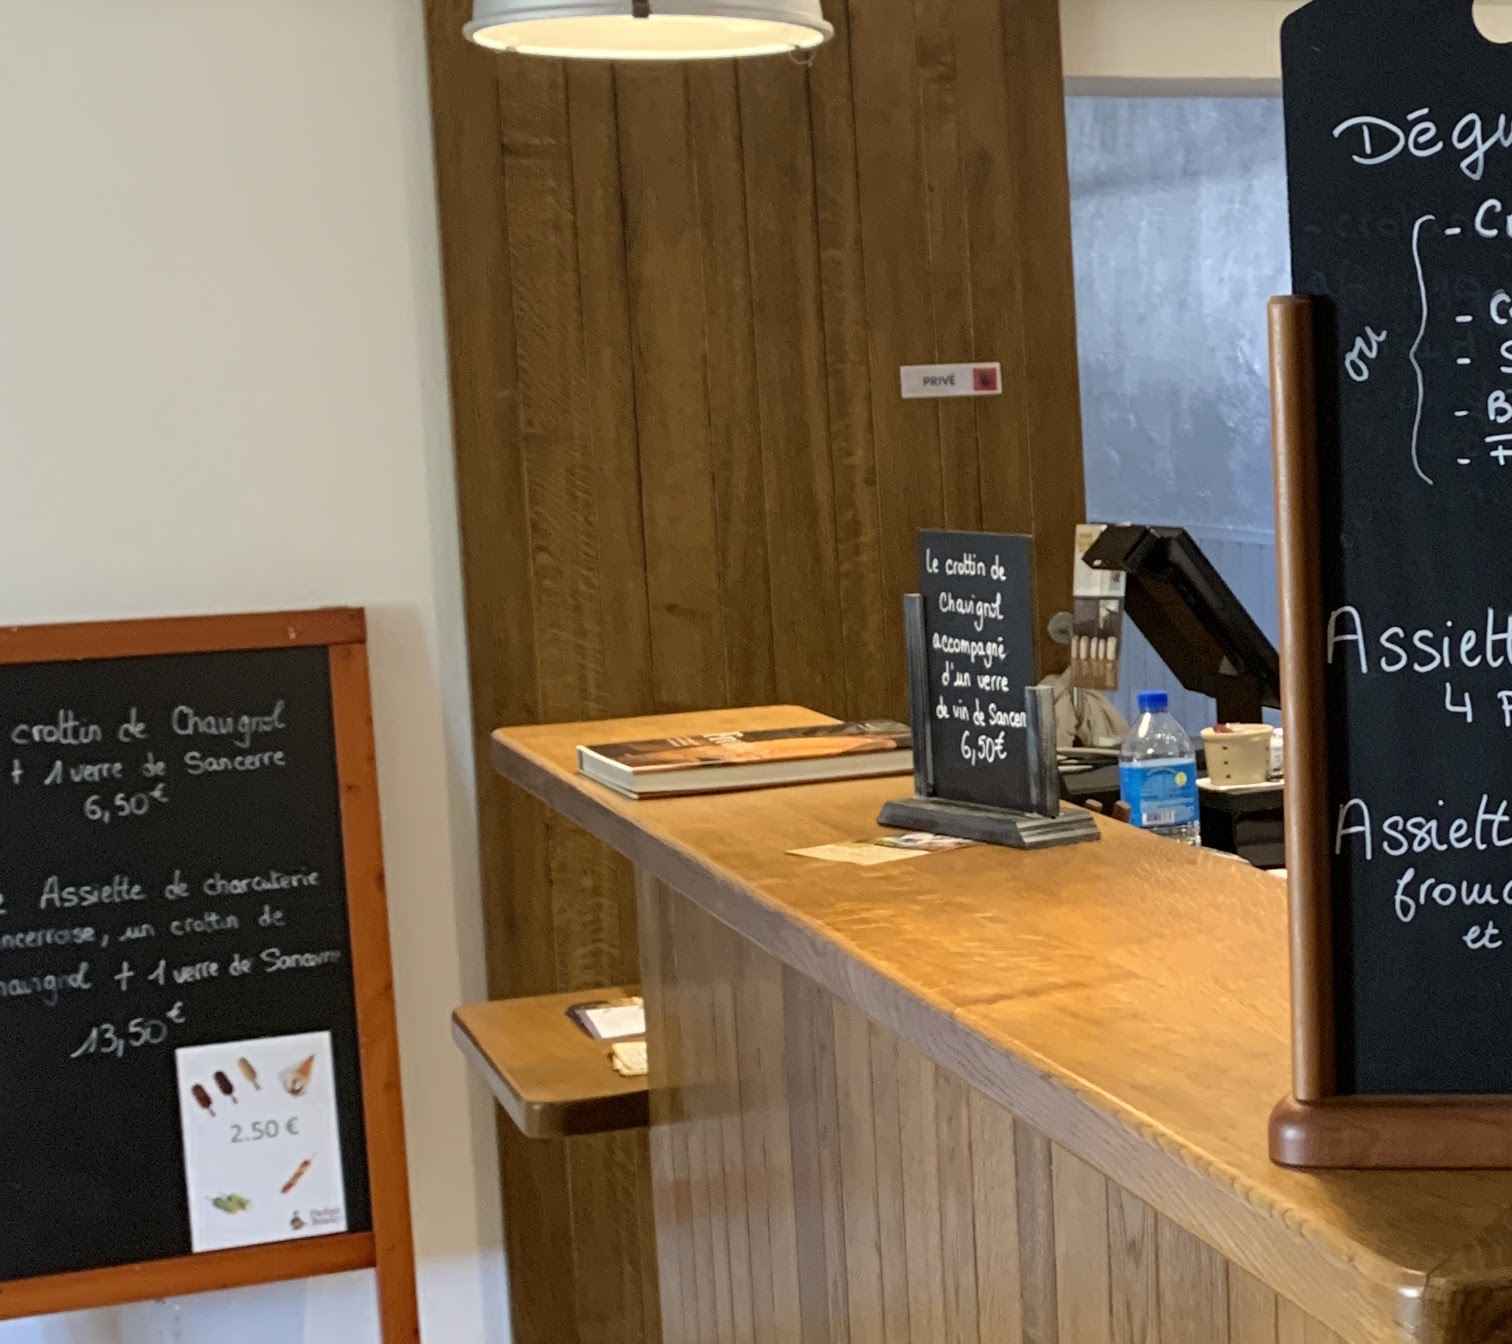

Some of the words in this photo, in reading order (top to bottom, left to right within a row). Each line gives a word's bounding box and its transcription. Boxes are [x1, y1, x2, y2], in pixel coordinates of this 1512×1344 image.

[945, 552, 986, 577] crottin
[990, 554, 1007, 582] de
[938, 591, 1004, 632] Chavignol
[932, 632, 1007, 670] accompagné
[941, 660, 971, 687] d'un
[976, 674, 1010, 693] verre
[935, 695, 950, 719] de
[952, 698, 970, 721] vin
[972, 697, 987, 727] de
[1445, 689, 1473, 723] 4
[11, 708, 102, 745] crottin
[118, 707, 146, 743] de
[960, 729, 1008, 766] 6,50€
[70, 762, 123, 783] verre
[143, 752, 166, 777] de
[183, 750, 286, 775] Sancerre
[84, 782, 168, 824] 6,50€
[39, 875, 145, 910] Assiette
[165, 869, 189, 900] de
[258, 904, 284, 927] de
[1462, 920, 1503, 949] et
[173, 961, 219, 984] verre
[228, 953, 251, 977] de
[70, 1001, 189, 1061] 13,50€
[231, 1119, 281, 1144] 2.50
[286, 1116, 300, 1136] €
